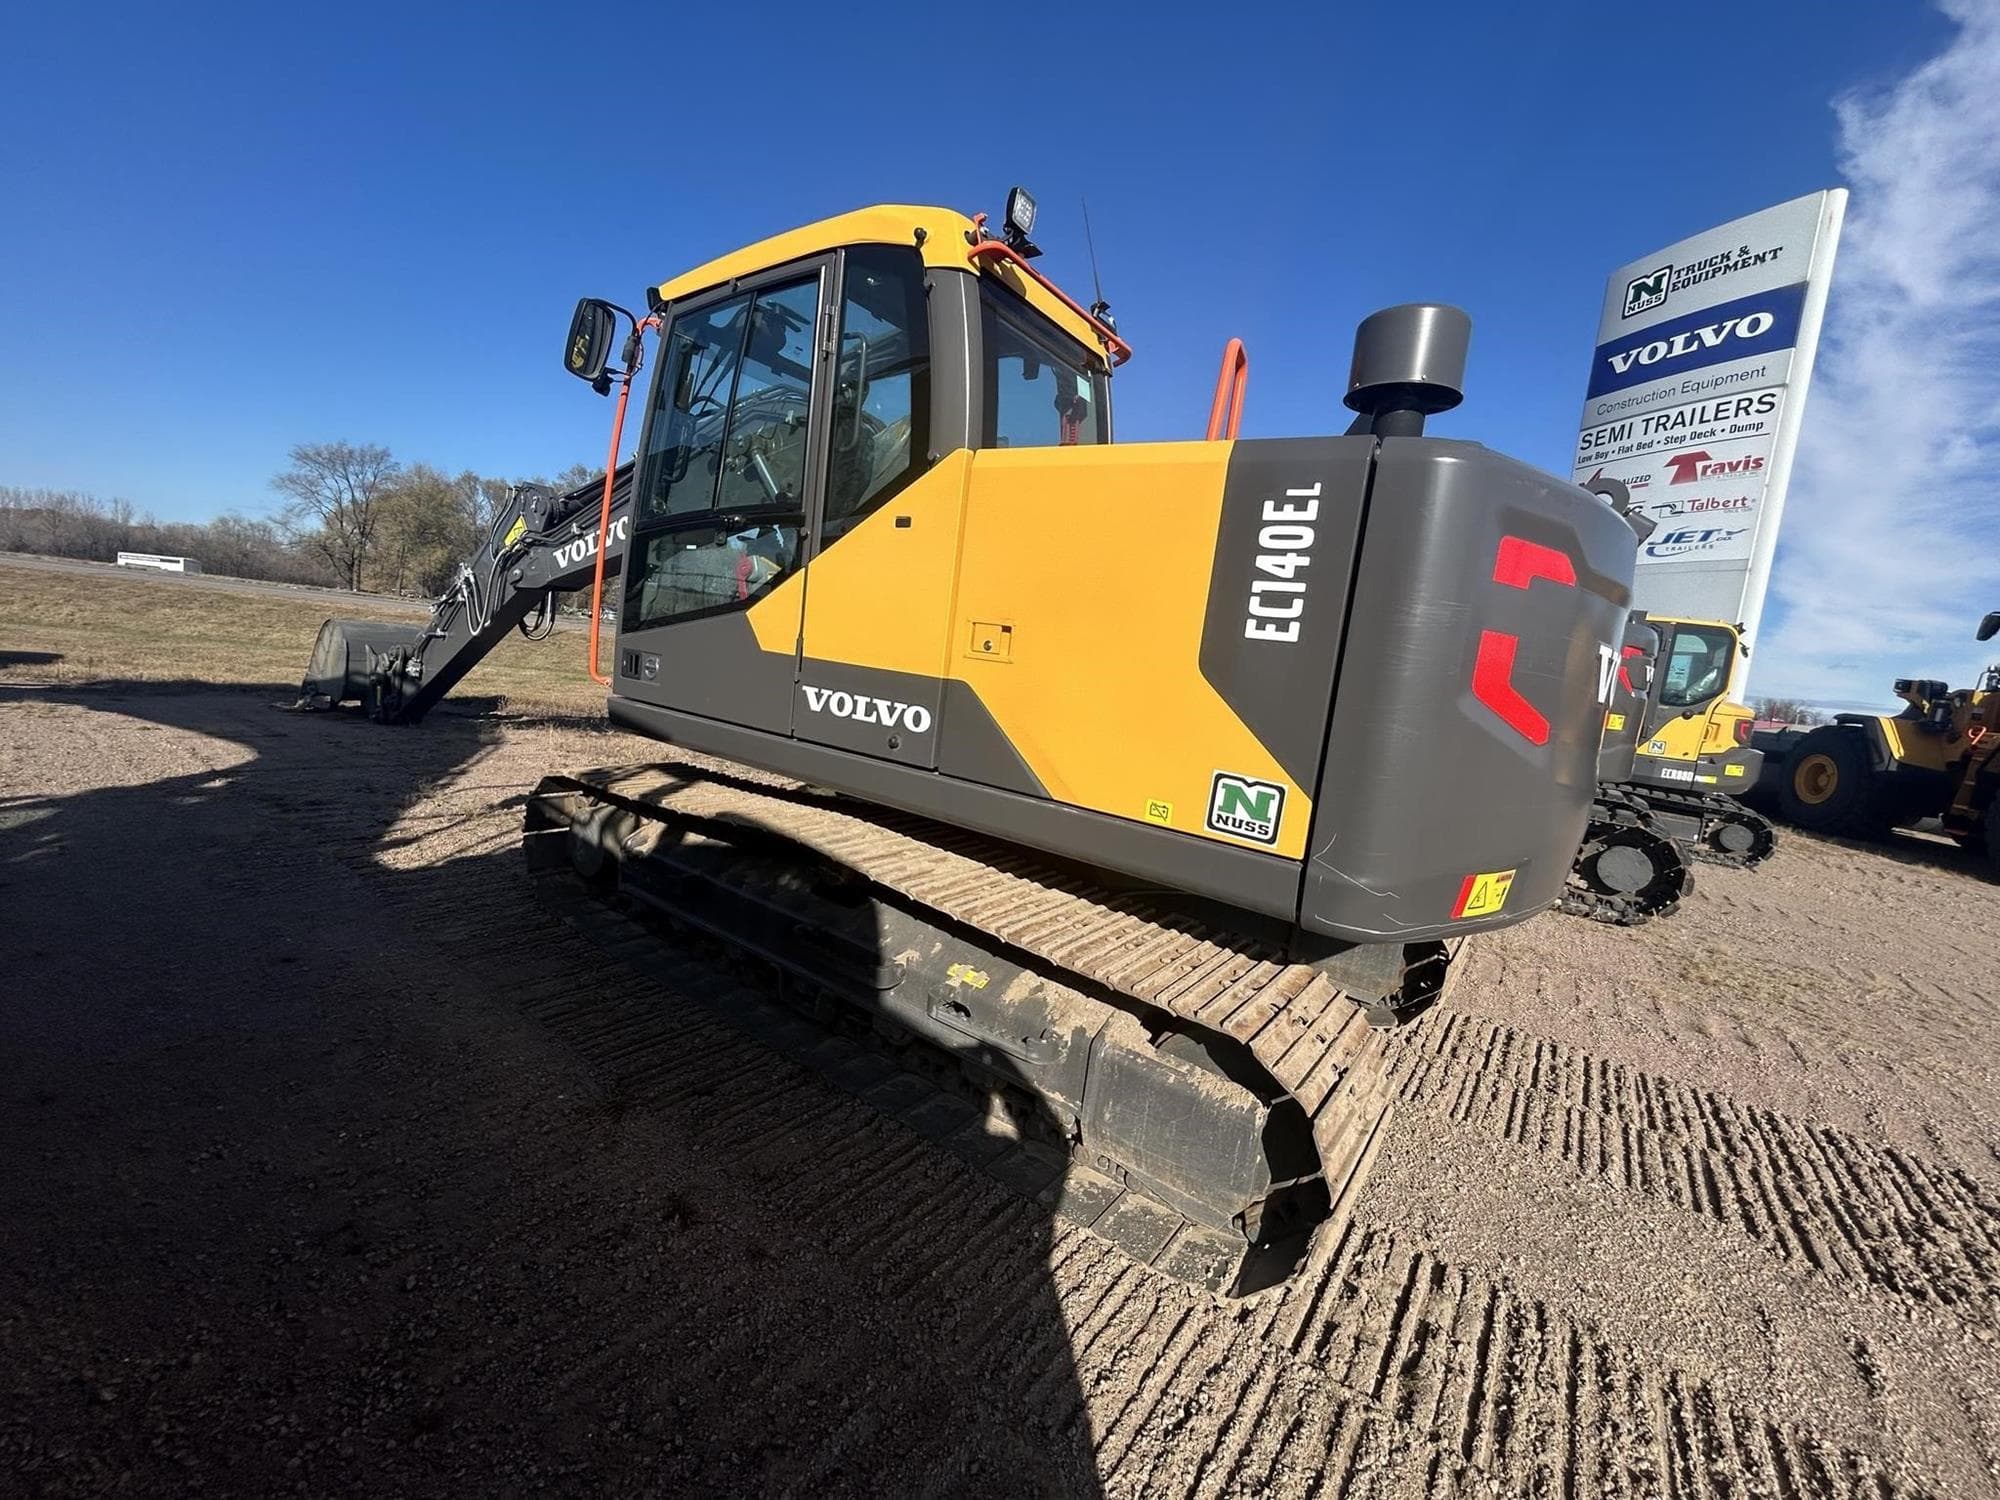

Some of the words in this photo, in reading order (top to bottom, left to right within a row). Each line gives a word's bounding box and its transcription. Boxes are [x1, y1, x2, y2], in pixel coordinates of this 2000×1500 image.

[1670, 247, 1783, 293] EQUIPMENT
[1674, 251, 1731, 280] TRUCK
[1737, 245, 1750, 257] &
[1626, 294, 1662, 313] NUSS
[1608, 312, 1774, 374] VOLVO
[1597, 387, 1676, 416] Construction
[1681, 366, 1767, 393] Equipment
[1578, 454, 1593, 464] Low
[1594, 450, 1610, 462] Boy
[1617, 444, 1634, 455] Flat
[1636, 440, 1654, 451] Bed
[1664, 433, 1686, 446] Step
[1690, 428, 1717, 441] Deck
[1729, 421, 1764, 434] Dump
[1580, 421, 1634, 451] SEMI
[1642, 393, 1777, 436] TRAILERS
[1664, 450, 1764, 486] Travis
[1687, 496, 1749, 512] Talbert
[1648, 528, 1723, 546] JET
[1245, 482, 1322, 643] EC140EL
[802, 685, 931, 733] VOLVO
[1217, 782, 1276, 824] N
[1215, 813, 1270, 836] NUSS
